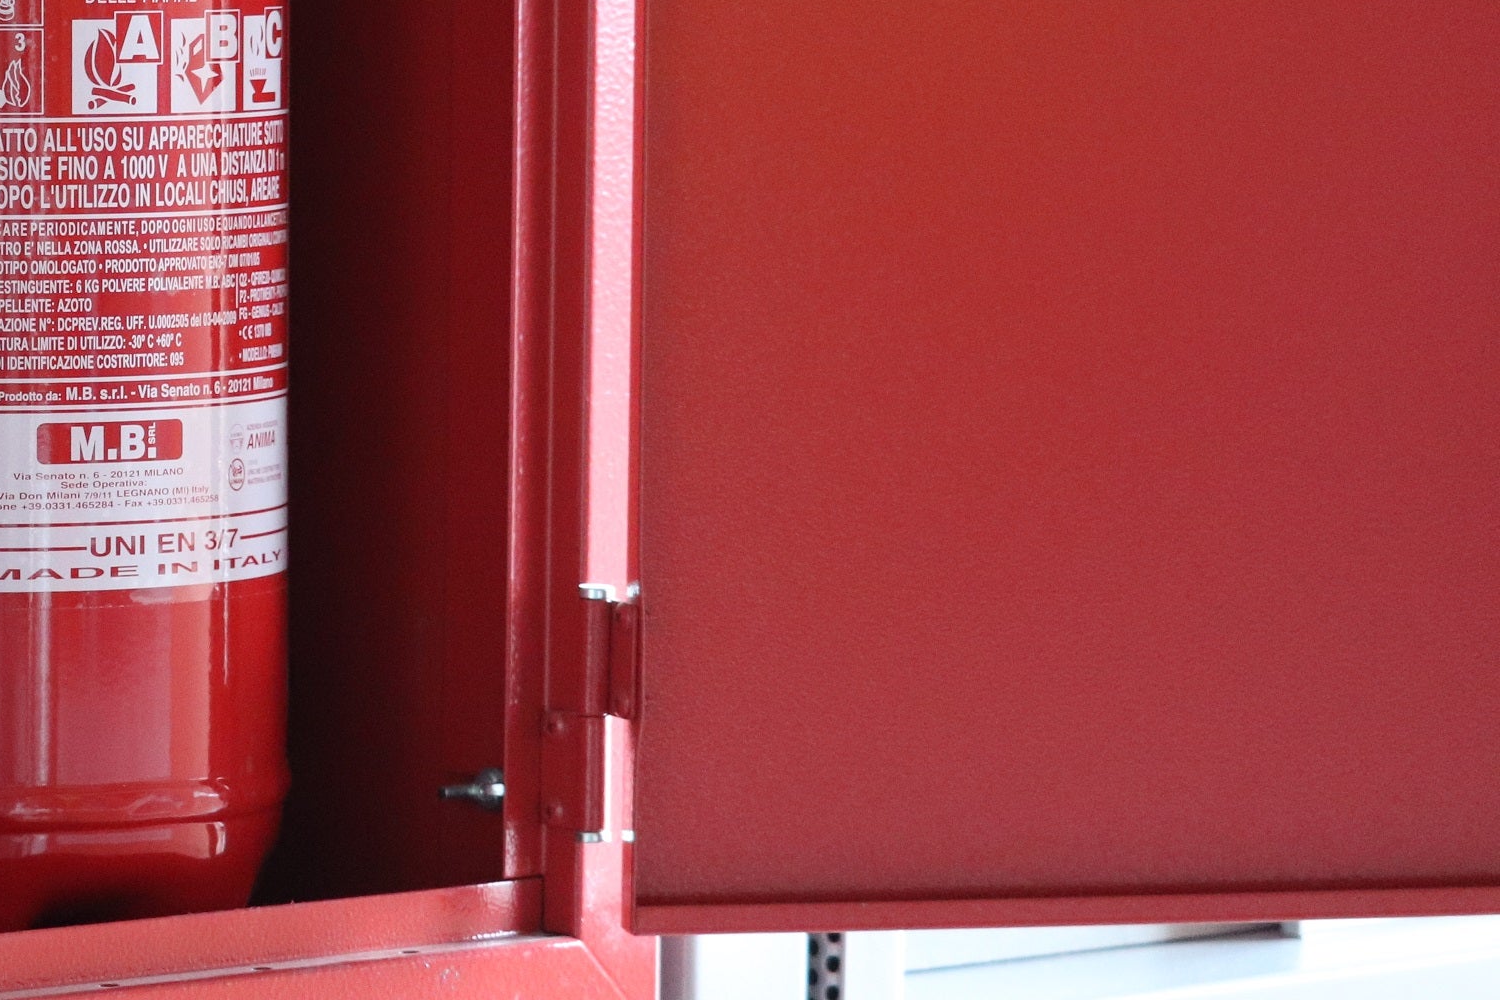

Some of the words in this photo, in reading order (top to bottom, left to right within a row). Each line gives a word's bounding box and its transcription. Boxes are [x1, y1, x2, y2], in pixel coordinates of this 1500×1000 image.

[119, 15, 159, 60] A
[210, 14, 238, 59] B
[43, 127, 117, 151] ALL'USO
[123, 127, 143, 150] SU
[149, 123, 262, 150] APPARECCHIATURE
[58, 156, 98, 180] FINO
[103, 156, 115, 179] A
[121, 156, 155, 179] 1000
[177, 155, 187, 177] A
[192, 154, 217, 177] UNA
[221, 151, 266, 175] DISTANZA
[40, 184, 129, 209] L'UTILIZZO
[135, 183, 150, 207] IN
[156, 183, 206, 207] LOCALI
[210, 180, 248, 207] CHIUSI,
[251, 177, 280, 202] AREARE
[30, 219, 139, 237] PERIODICAMENTE,
[142, 220, 170, 234] DOPO
[172, 219, 196, 233] OGNI
[197, 218, 215, 232] USO
[37, 241, 71, 255] NELLA
[74, 240, 102, 254] ZONA
[150, 237, 198, 253] UTILIZZARE
[200, 236, 221, 251] SOLO
[31, 260, 96, 274] OMOLOGATO
[105, 259, 156, 273] PRODOTTO
[158, 256, 207, 272] APPROVATO
[85, 279, 99, 292] KG
[102, 278, 145, 292] POLVERE
[148, 275, 203, 291] POLIVALENTE
[57, 298, 92, 312] AZOTO
[127, 316, 146, 330] UFF.
[31, 337, 64, 351] LIMITE
[68, 336, 77, 350] DI
[80, 335, 126, 350] UTILIZZO:
[7, 355, 94, 370] IDENTIFICAZIONE
[97, 352, 167, 369] COSTRUTTORE:
[46, 391, 61, 400] da:
[66, 387, 96, 400] M.B.
[138, 385, 157, 398] Via
[161, 383, 200, 398] Senato
[228, 378, 251, 392] 20121
[247, 430, 275, 449] ANIMA
[36, 472, 75, 480] Senato
[111, 470, 140, 479] 20121
[145, 468, 183, 477] MILANO
[61, 481, 88, 489] Sede
[93, 480, 147, 489] Operativa:
[20, 492, 43, 500] Don
[47, 492, 80, 500] Milani
[116, 488, 169, 497] LEGNANO
[21, 501, 114, 510] +39.0331.465284
[125, 499, 143, 508] Fax
[90, 536, 145, 558] UNI
[158, 532, 195, 554] EN
[205, 529, 239, 551] 3/7
[158, 562, 197, 575] IN
[214, 549, 281, 570] ITALY
